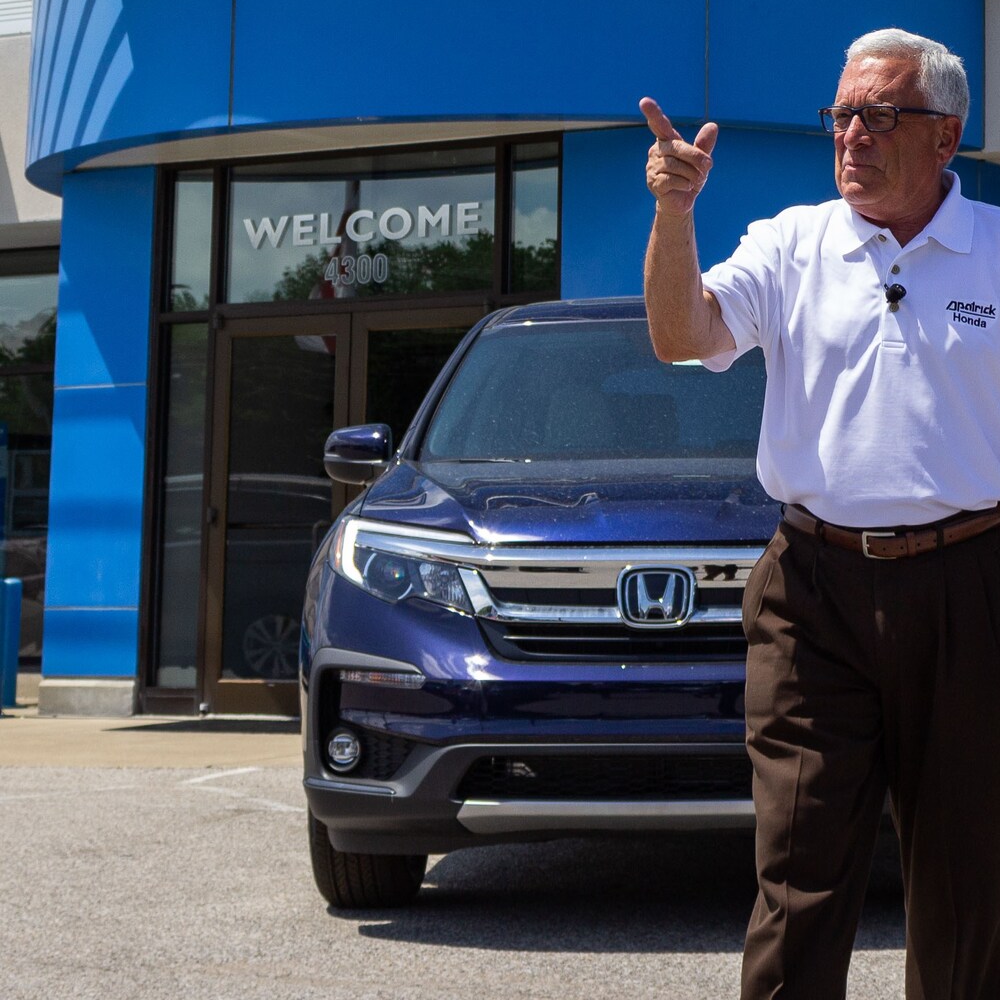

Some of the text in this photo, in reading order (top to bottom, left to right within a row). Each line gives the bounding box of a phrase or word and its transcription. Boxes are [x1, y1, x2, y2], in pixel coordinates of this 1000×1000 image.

[242, 201, 481, 250] WELCOME
[323, 252, 389, 287] 4300
[953, 311, 987, 329] Honda
